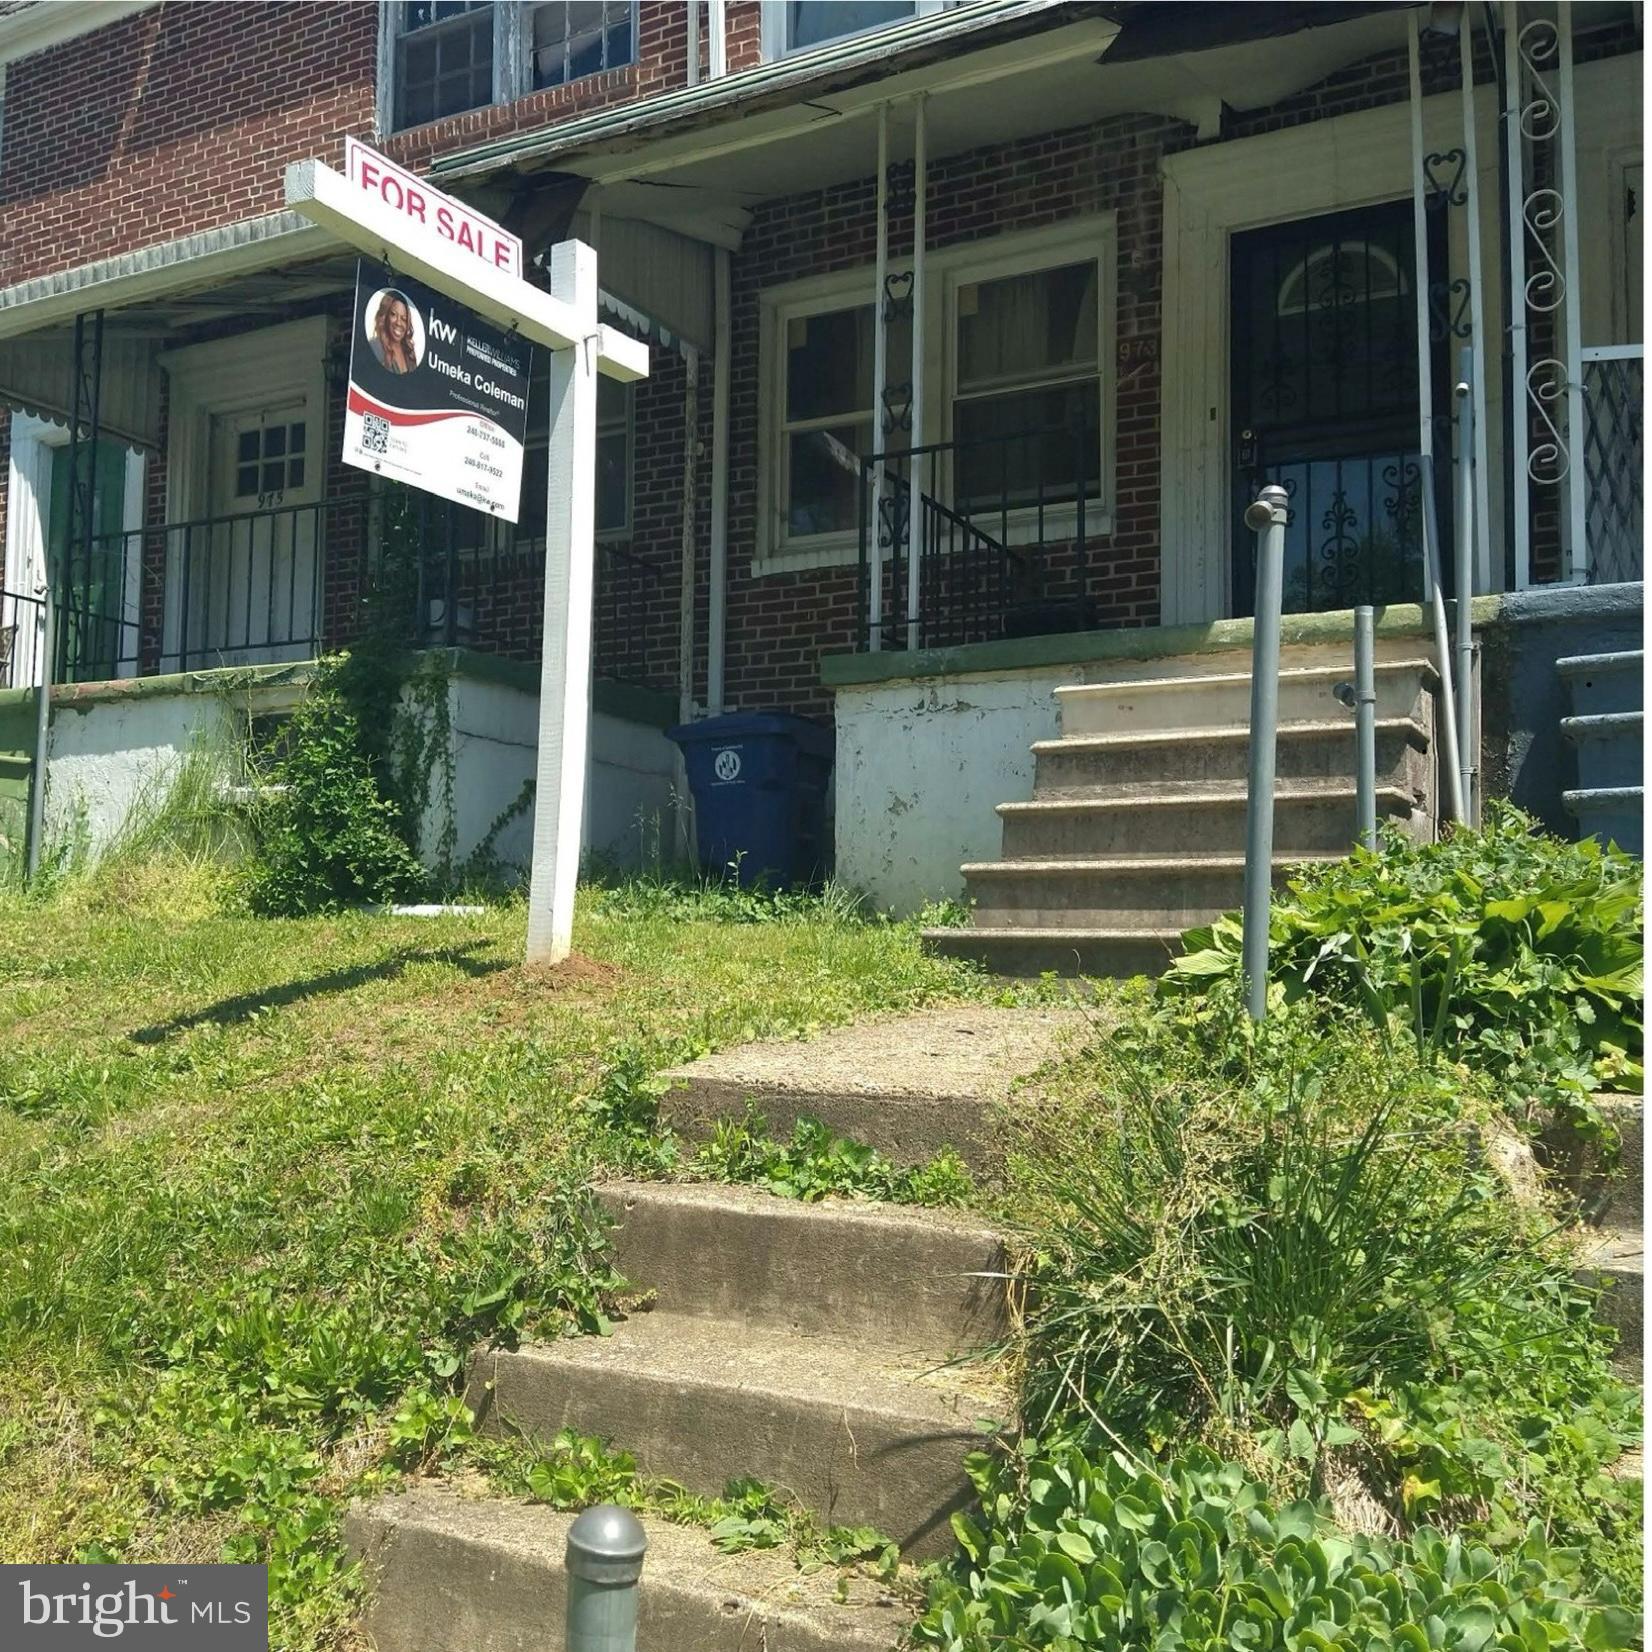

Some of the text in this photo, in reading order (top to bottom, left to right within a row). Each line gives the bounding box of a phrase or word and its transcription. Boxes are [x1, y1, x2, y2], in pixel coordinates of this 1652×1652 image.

[361, 160, 511, 274] FOR SALE
[428, 351, 525, 411] Umeka Coleman
